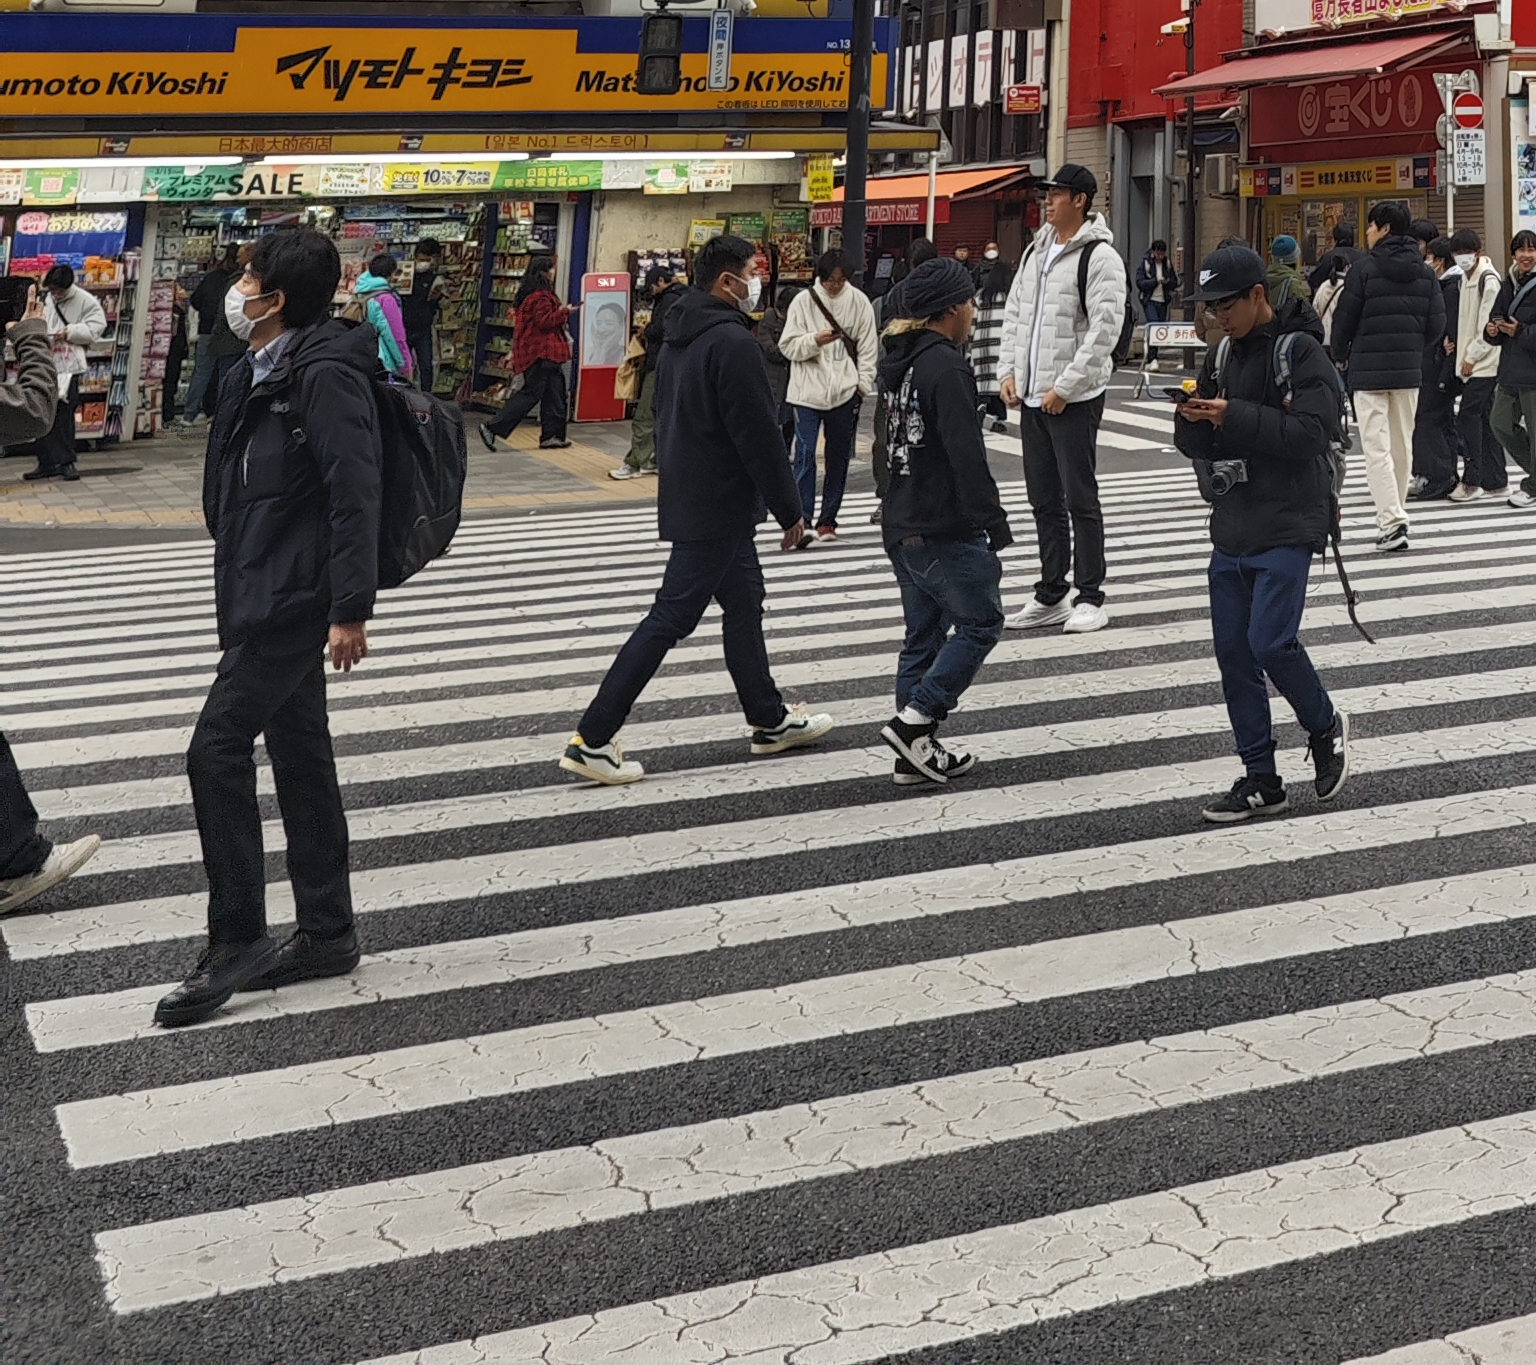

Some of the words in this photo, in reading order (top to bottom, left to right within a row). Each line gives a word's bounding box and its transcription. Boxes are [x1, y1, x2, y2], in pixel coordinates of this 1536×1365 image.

[106, 71, 230, 95] KiYoshi
[276, 45, 534, 101] マツモトキヨシ
[744, 70, 846, 93] KiYoshi
[761, 100, 779, 109] LED
[1324, 79, 1393, 133] 宝くじ
[219, 136, 332, 153] 日本最大的药店
[526, 135, 558, 148] No.1
[166, 187, 228, 199] ウィンター
[228, 173, 304, 196] SALE
[168, 174, 227, 187] プレミアム
[48, 212, 127, 233] おすすめマスク
[897, 204, 919, 221] STORE
